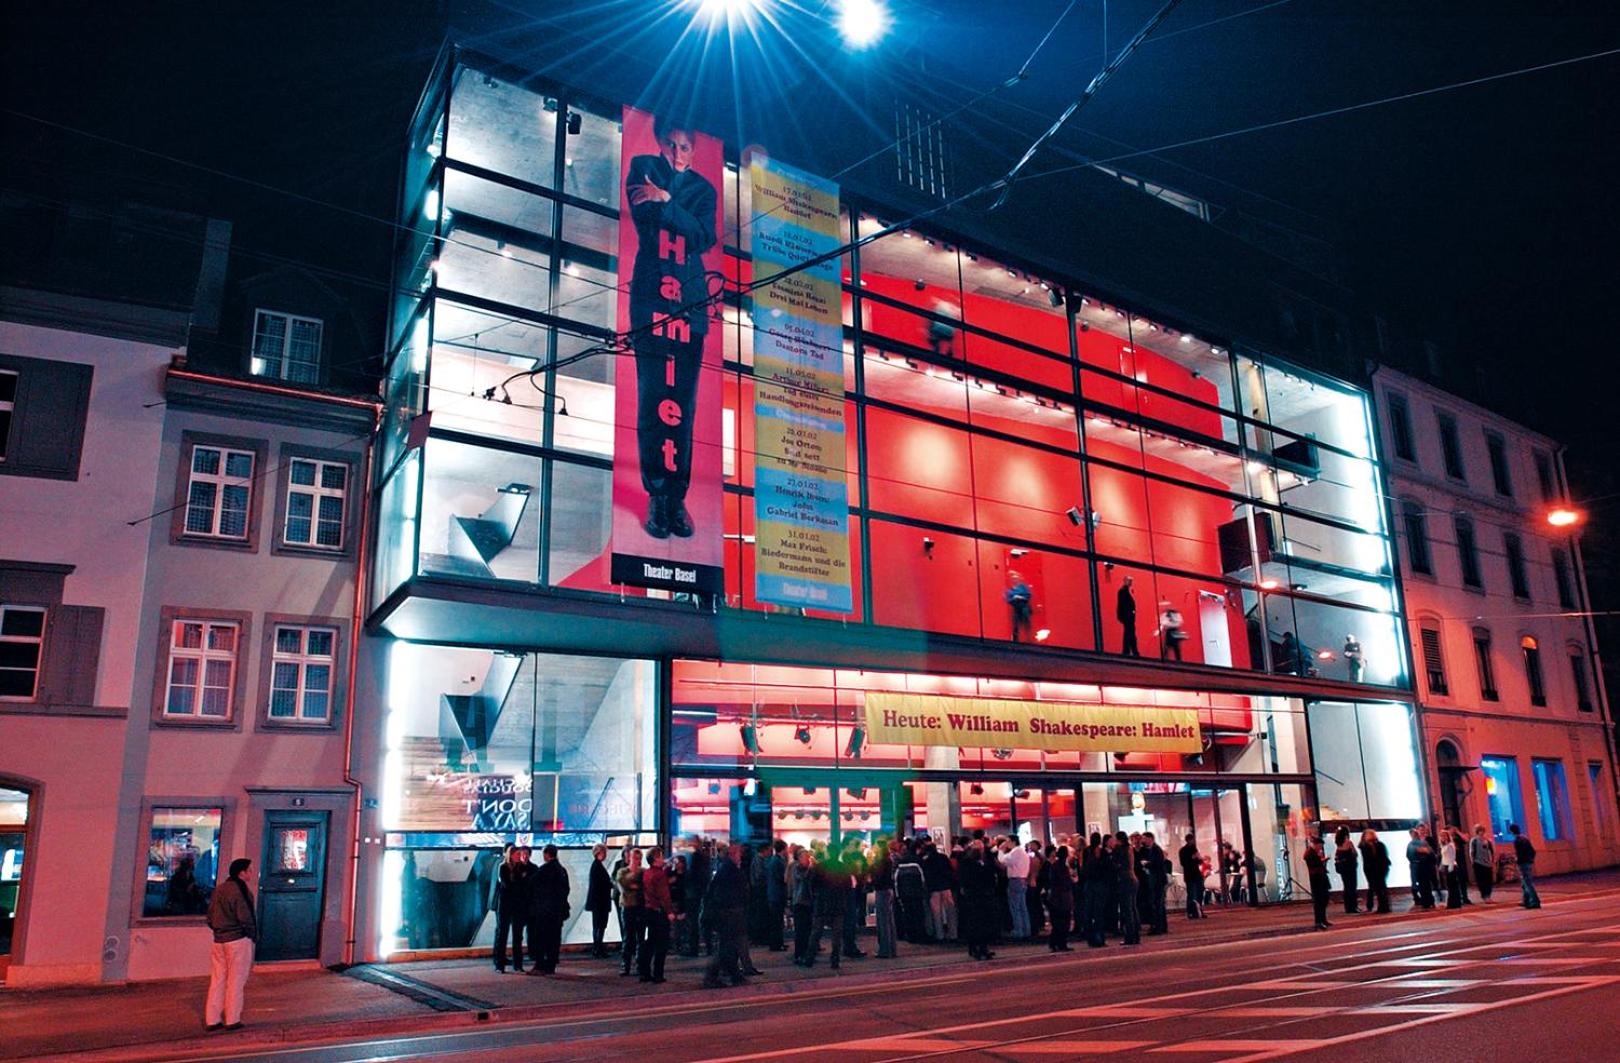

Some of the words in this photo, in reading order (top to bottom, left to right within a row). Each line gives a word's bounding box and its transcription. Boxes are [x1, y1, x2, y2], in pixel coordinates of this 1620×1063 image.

[652, 229, 691, 472] Hamlet
[766, 506, 798, 520] Gabriel
[780, 538, 797, 550] Max
[760, 547, 813, 563] Biedermann
[815, 557, 831, 566] und
[832, 559, 846, 568] die
[643, 563, 673, 580] Theater
[674, 567, 697, 583] Basel
[778, 561, 830, 576] Brandstifter
[883, 709, 942, 729] Heute:
[946, 713, 1019, 732] William
[1029, 717, 1137, 739] Shakespeare:
[1141, 722, 1195, 738] Hamlet
